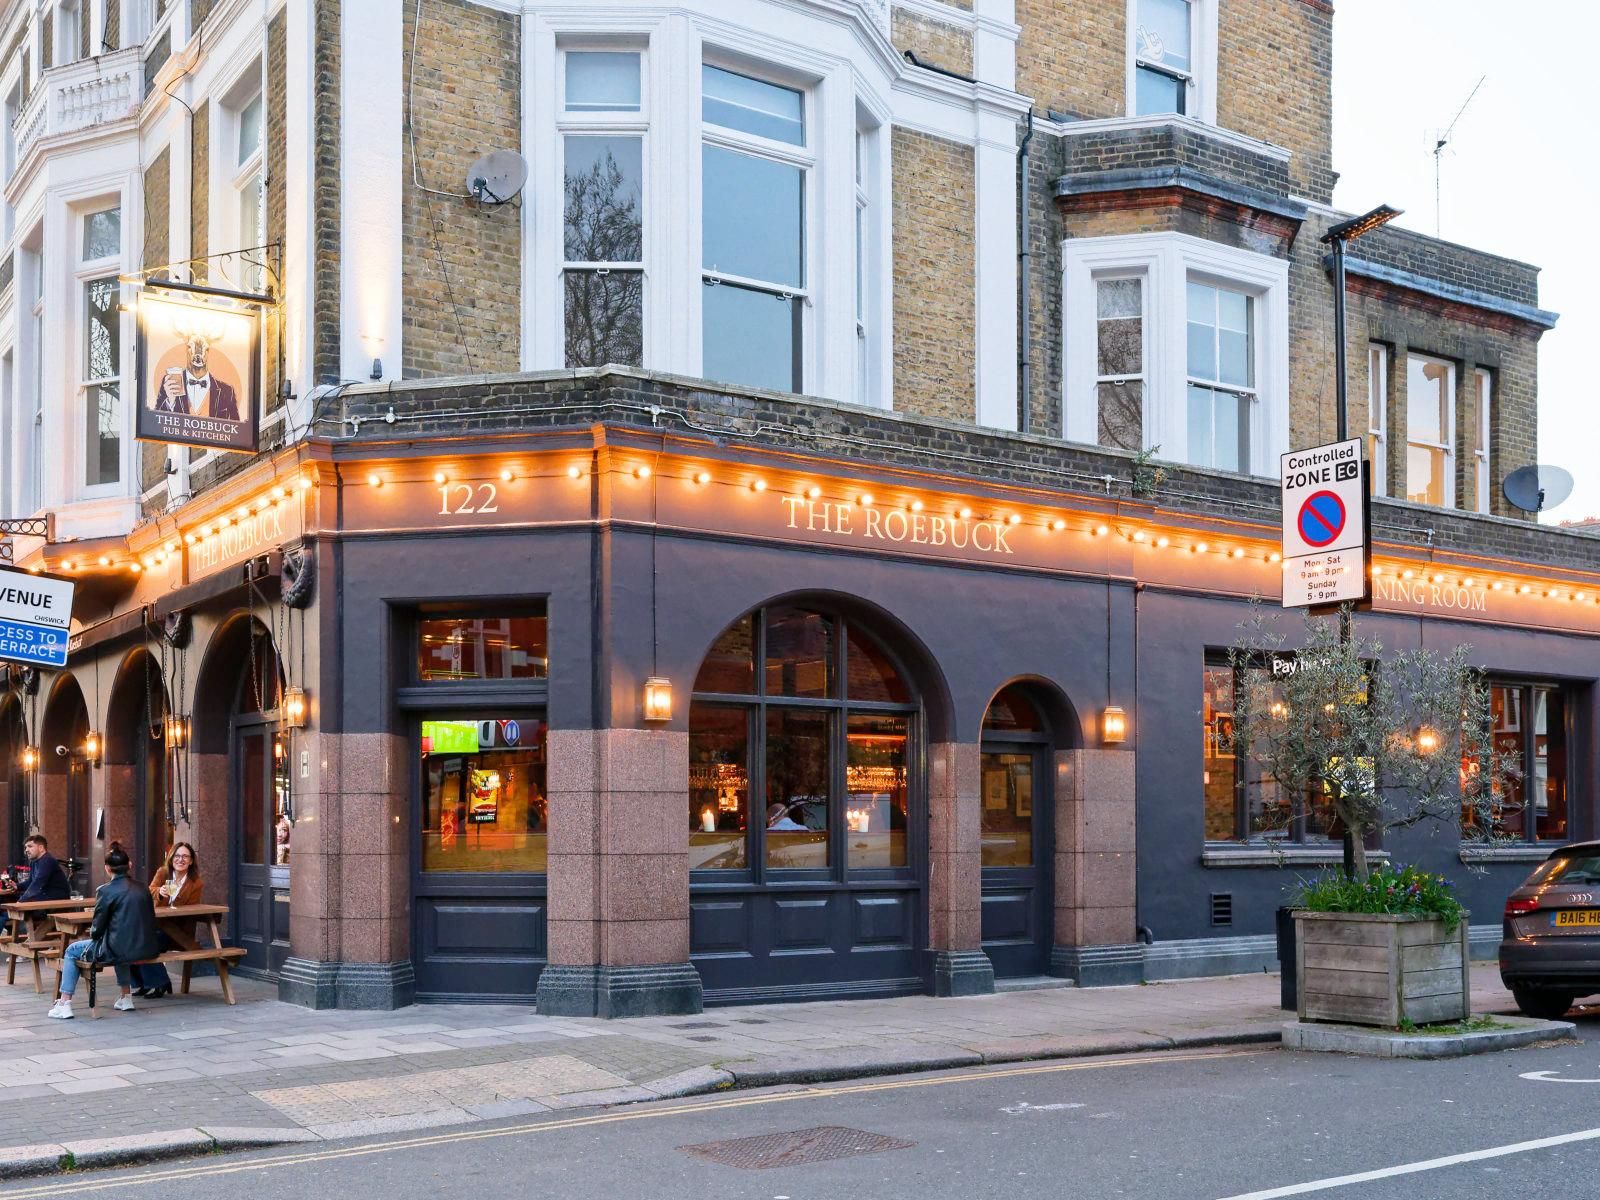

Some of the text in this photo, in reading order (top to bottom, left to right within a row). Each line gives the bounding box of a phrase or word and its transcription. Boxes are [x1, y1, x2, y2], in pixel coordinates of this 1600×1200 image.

[155, 414, 239, 434] THE ROEBUCK
[163, 427, 180, 435] PUB
[192, 430, 231, 442] KITCHEN
[1288, 445, 1354, 470] Controlled
[1286, 463, 1357, 490] ZONE EC
[437, 483, 499, 515] 122
[782, 496, 1014, 554] THE ROEBUCK
[192, 508, 282, 572] THE ROEBUCK
[1304, 560, 1321, 568] Mon
[1327, 555, 1341, 565] Sat
[1307, 580, 1337, 590] Sunday
[1372, 578, 1487, 612] NING ROOM
[34, 614, 65, 625] CHISWICK
[39, 632, 57, 645] TO
[1273, 659, 1297, 677] Pay
[1560, 912, 1586, 924] BA16
